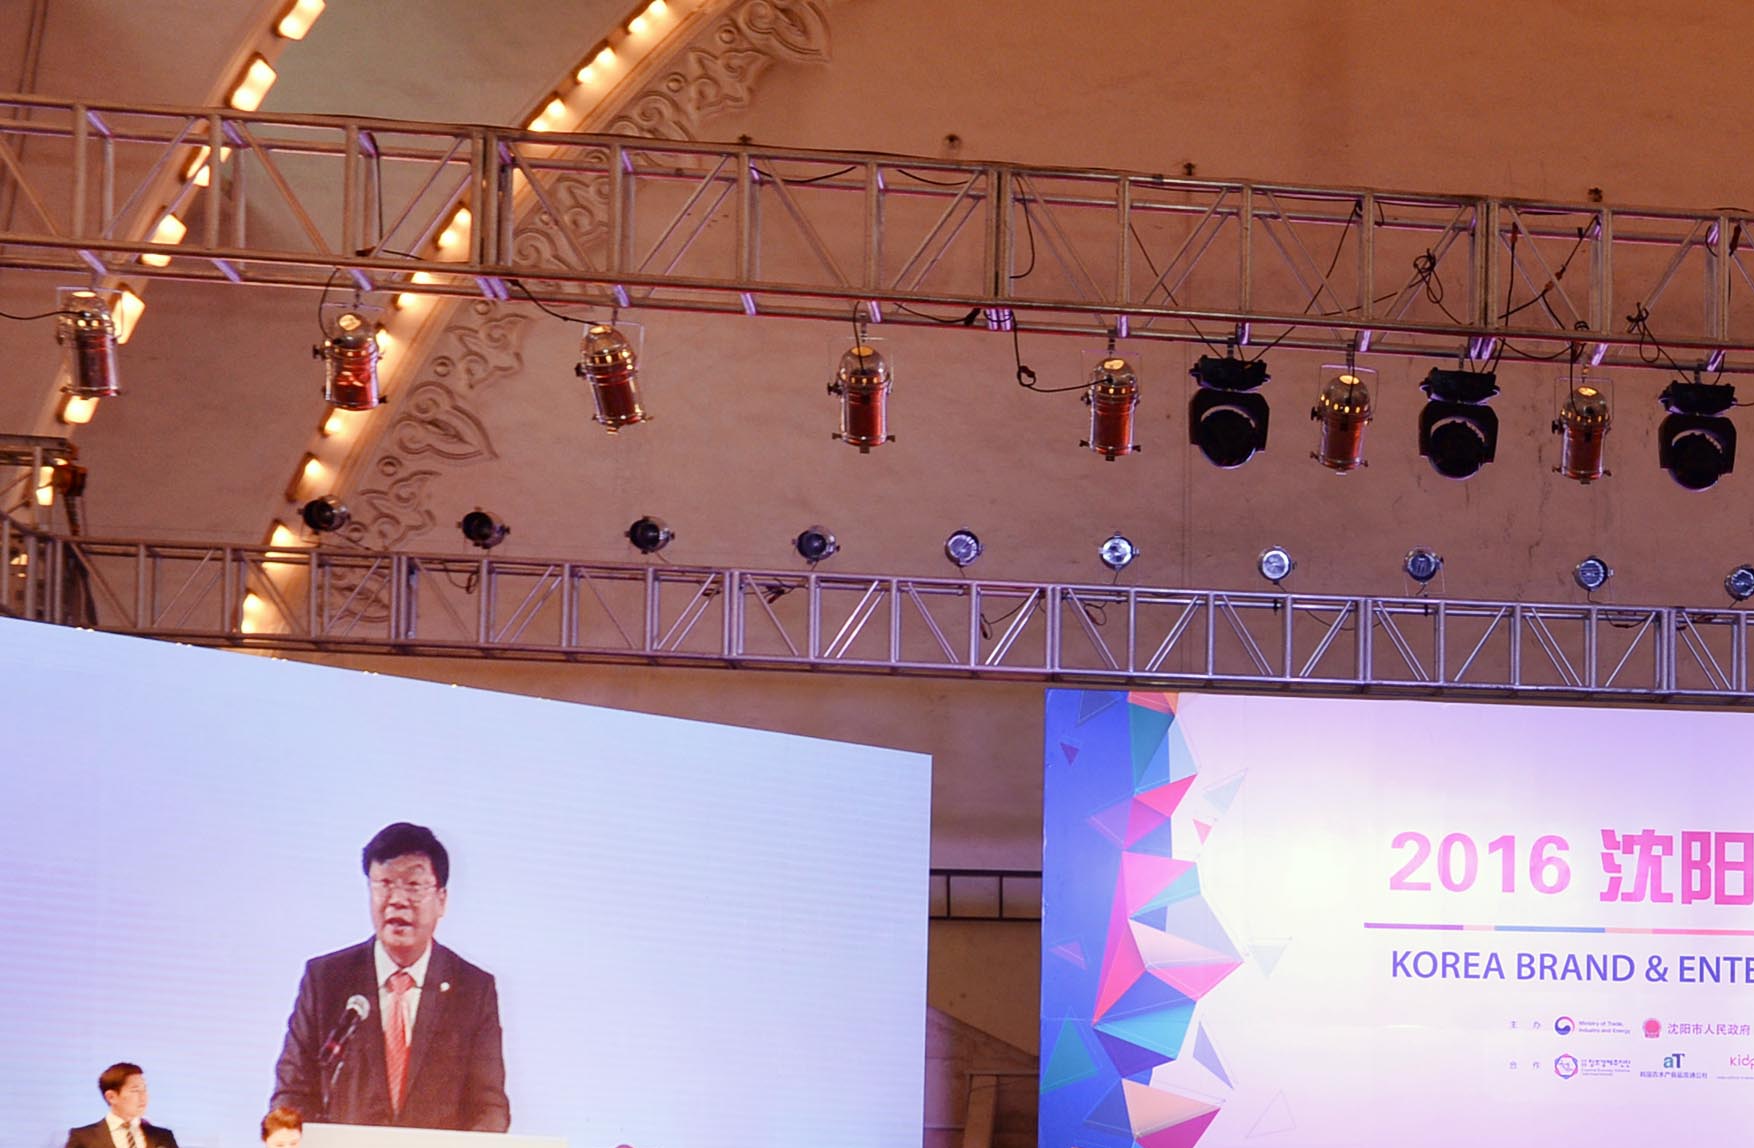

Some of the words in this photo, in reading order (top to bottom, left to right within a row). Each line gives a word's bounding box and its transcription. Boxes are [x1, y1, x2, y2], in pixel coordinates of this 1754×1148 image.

[1389, 831, 1571, 894] 2016
[1599, 828, 1754, 906] 沈阳
[1391, 950, 1505, 980] KOREA
[1516, 952, 1635, 982] BRAND
[1644, 955, 1669, 983] &
[1668, 1023, 1750, 1036] 沈阳市人民政府
